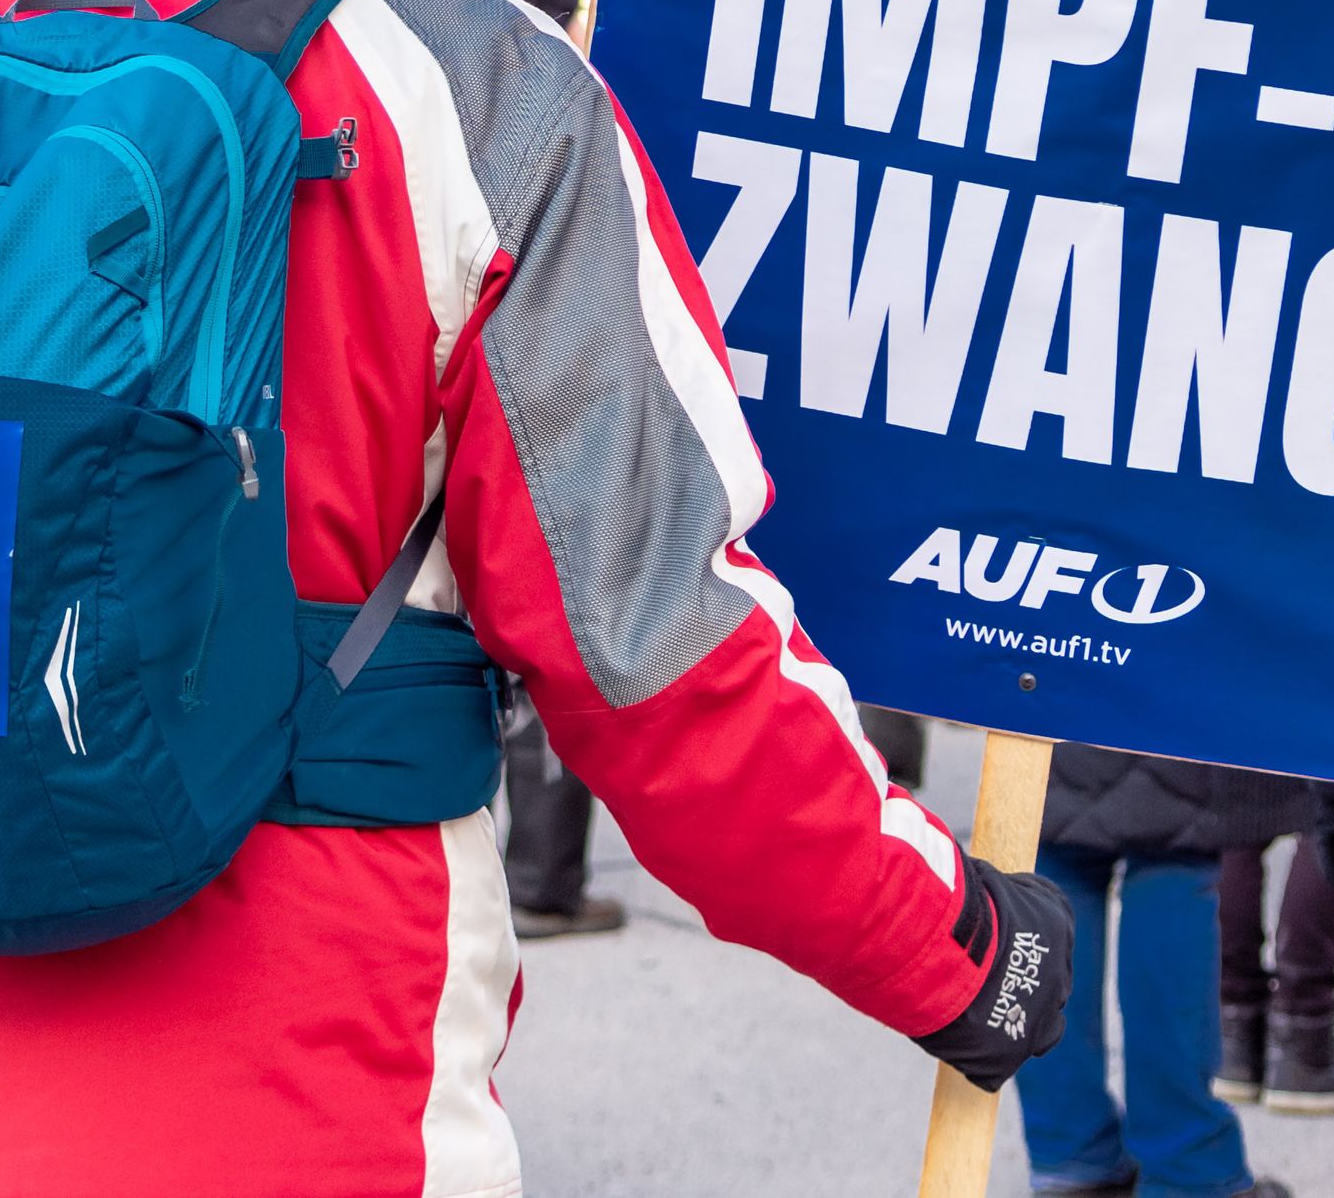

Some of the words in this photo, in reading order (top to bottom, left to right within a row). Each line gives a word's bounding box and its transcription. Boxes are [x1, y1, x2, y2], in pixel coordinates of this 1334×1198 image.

[945, 617, 1132, 666] www.auf1.tv
[987, 931, 1034, 1029] Wolfskin
[1019, 932, 1050, 996] Jack
